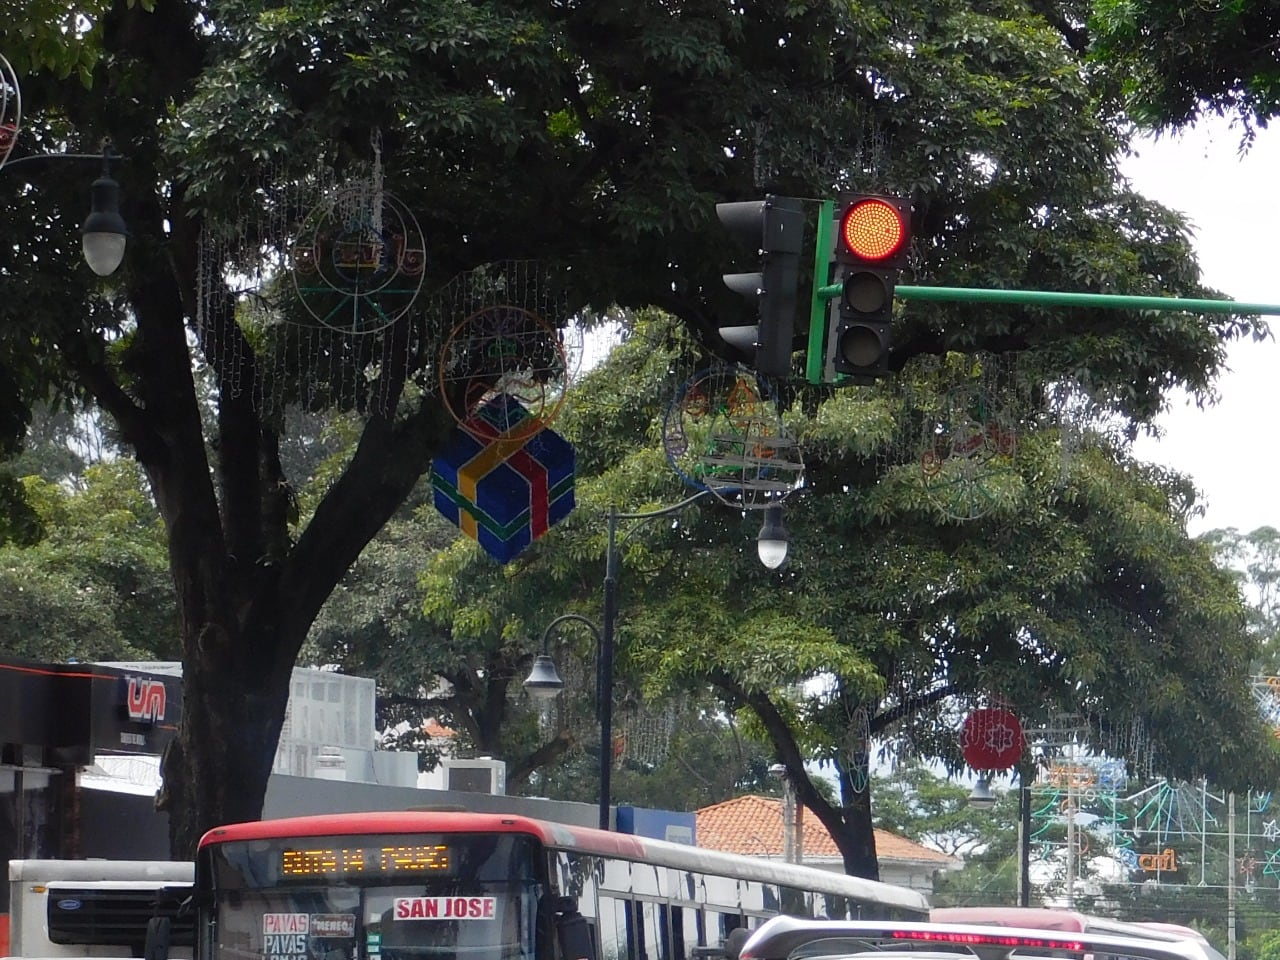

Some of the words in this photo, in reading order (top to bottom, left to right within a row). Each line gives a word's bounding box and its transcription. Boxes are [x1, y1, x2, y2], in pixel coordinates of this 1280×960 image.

[397, 899, 439, 919] SAN
[444, 898, 494, 918] JOSE
[265, 914, 308, 934] PAVAS
[264, 935, 306, 953] PAVAS
